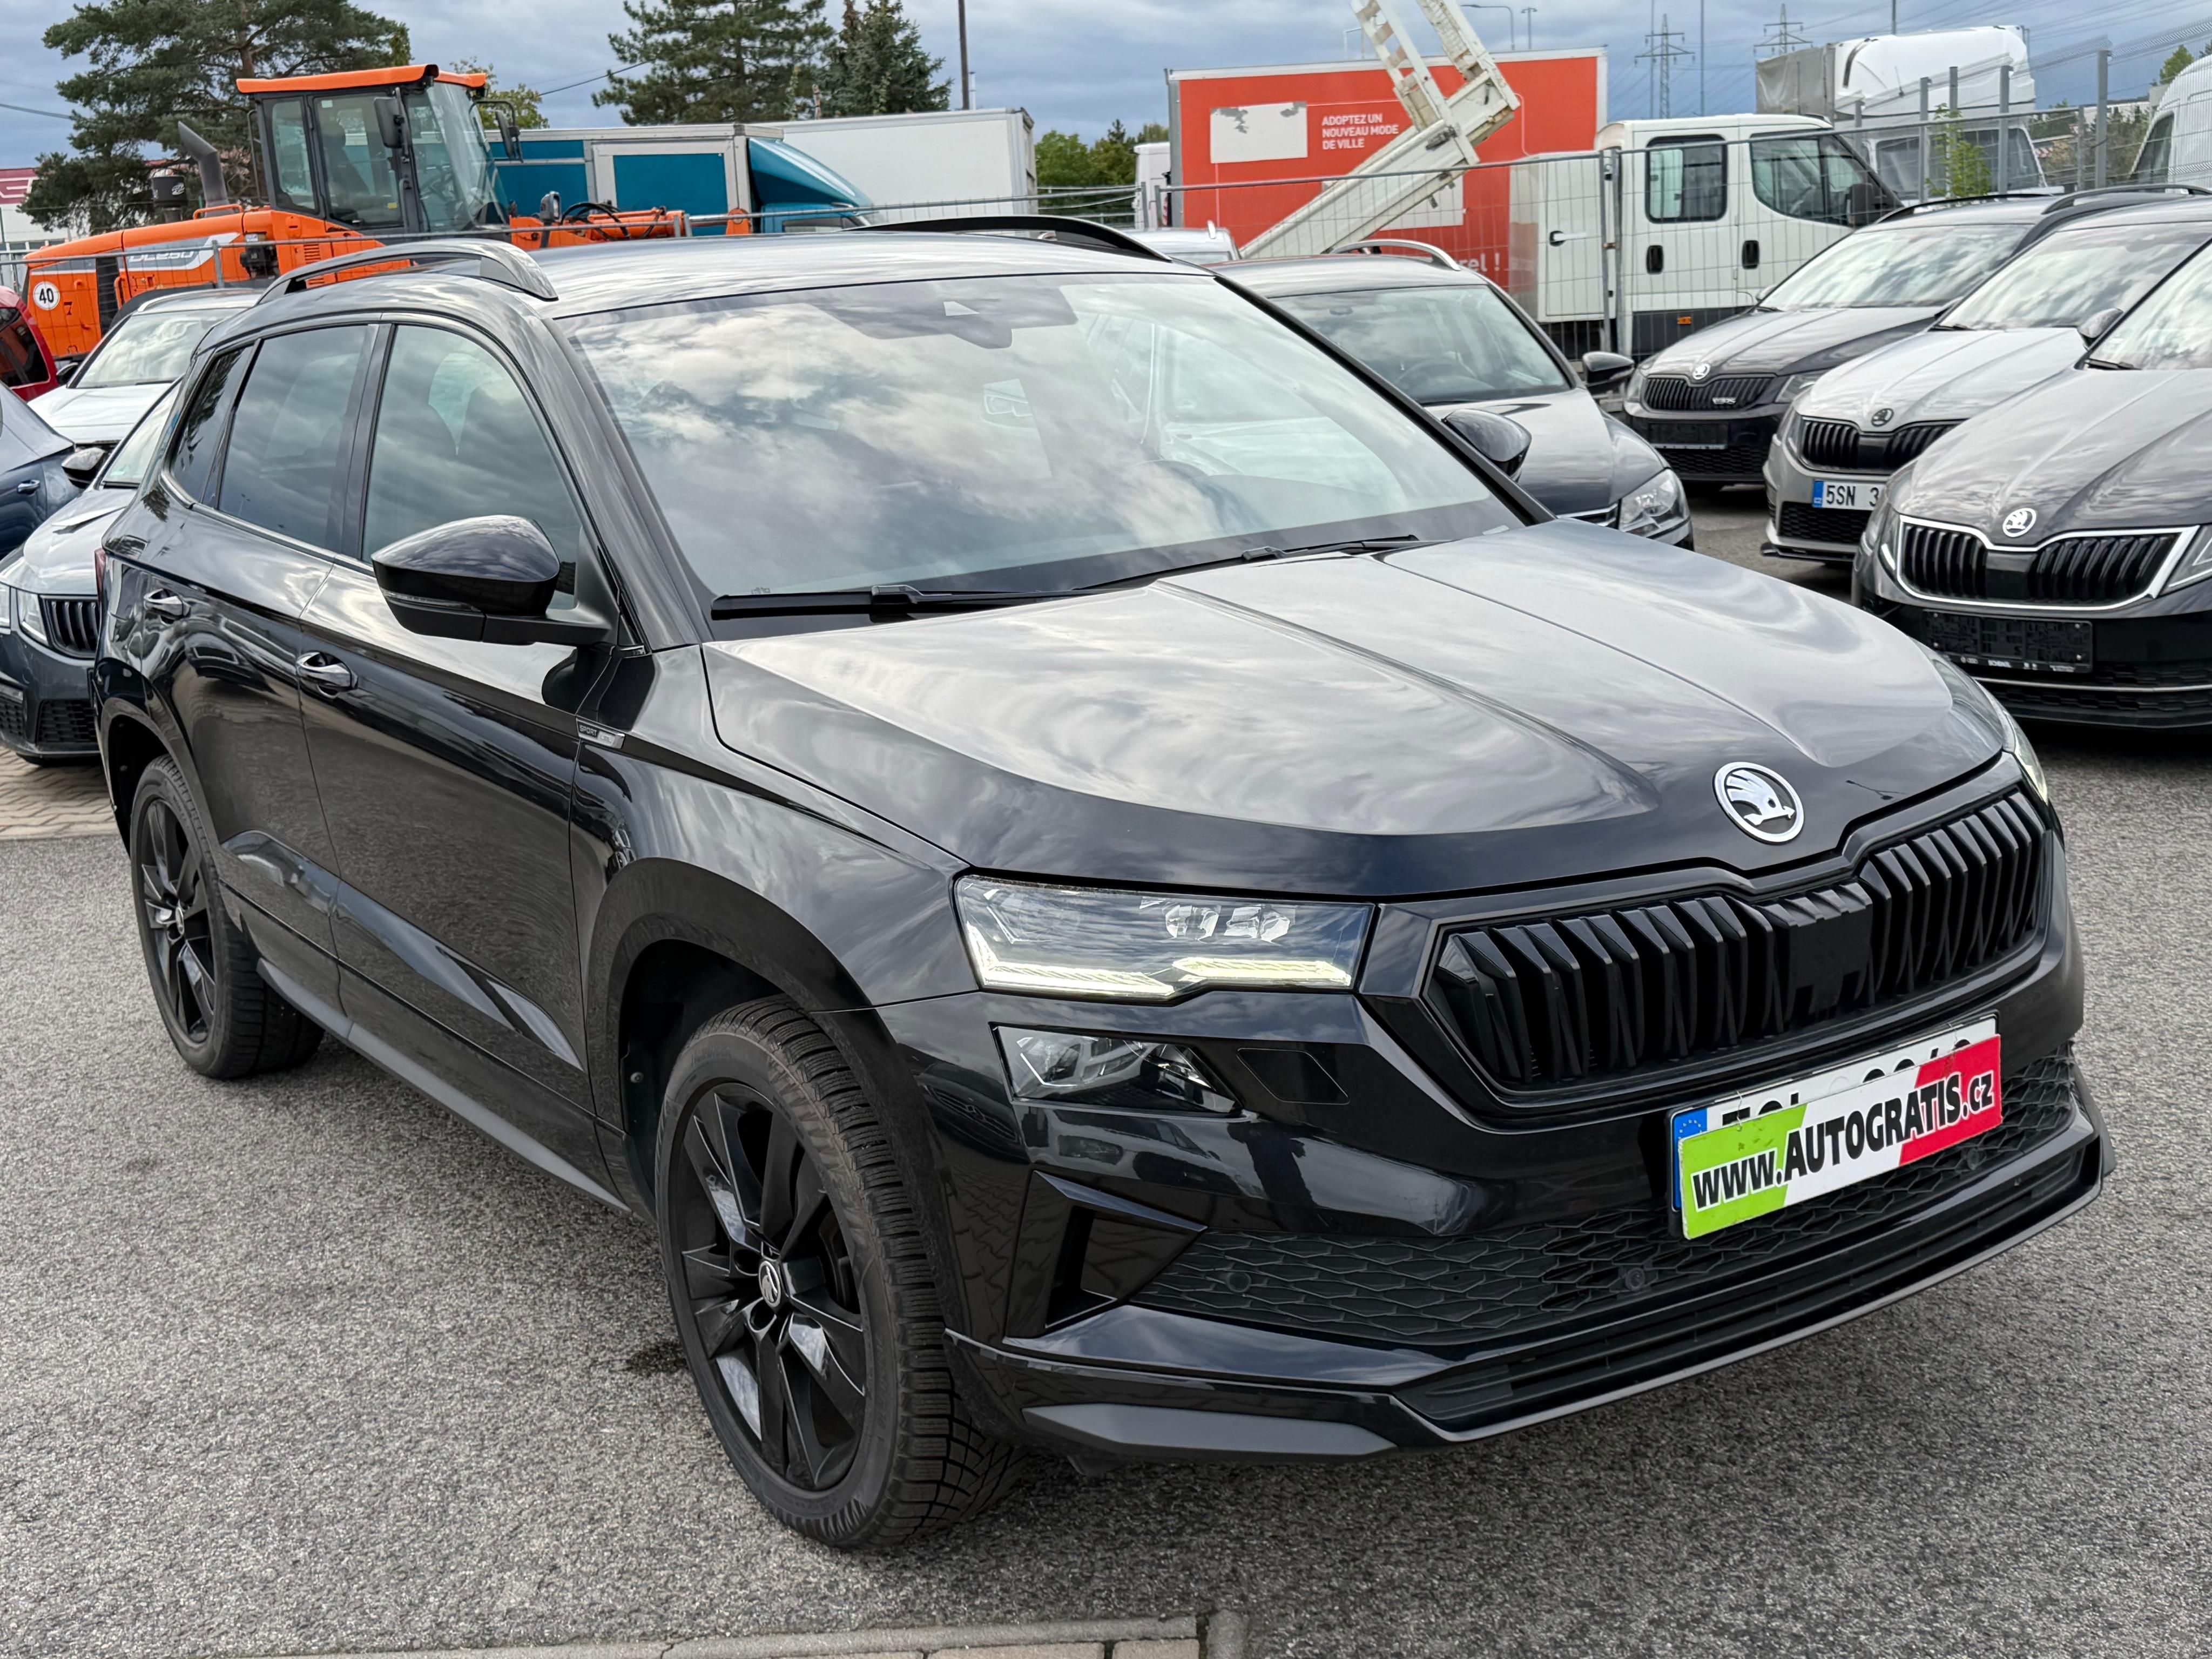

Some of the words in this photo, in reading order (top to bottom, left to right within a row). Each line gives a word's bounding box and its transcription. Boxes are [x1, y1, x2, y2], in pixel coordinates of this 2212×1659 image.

[1321, 114, 1367, 126] ADOPTEZ
[1367, 113, 1383, 123] UN
[1322, 125, 1368, 138] NOUVEAU
[1370, 124, 1399, 135] MODE
[1322, 140, 1336, 150] DE
[1337, 138, 1365, 149] VILLE
[39, 287, 54, 304] 40
[1826, 485, 1856, 506] 5SN
[579, 725, 597, 736] SPORT
